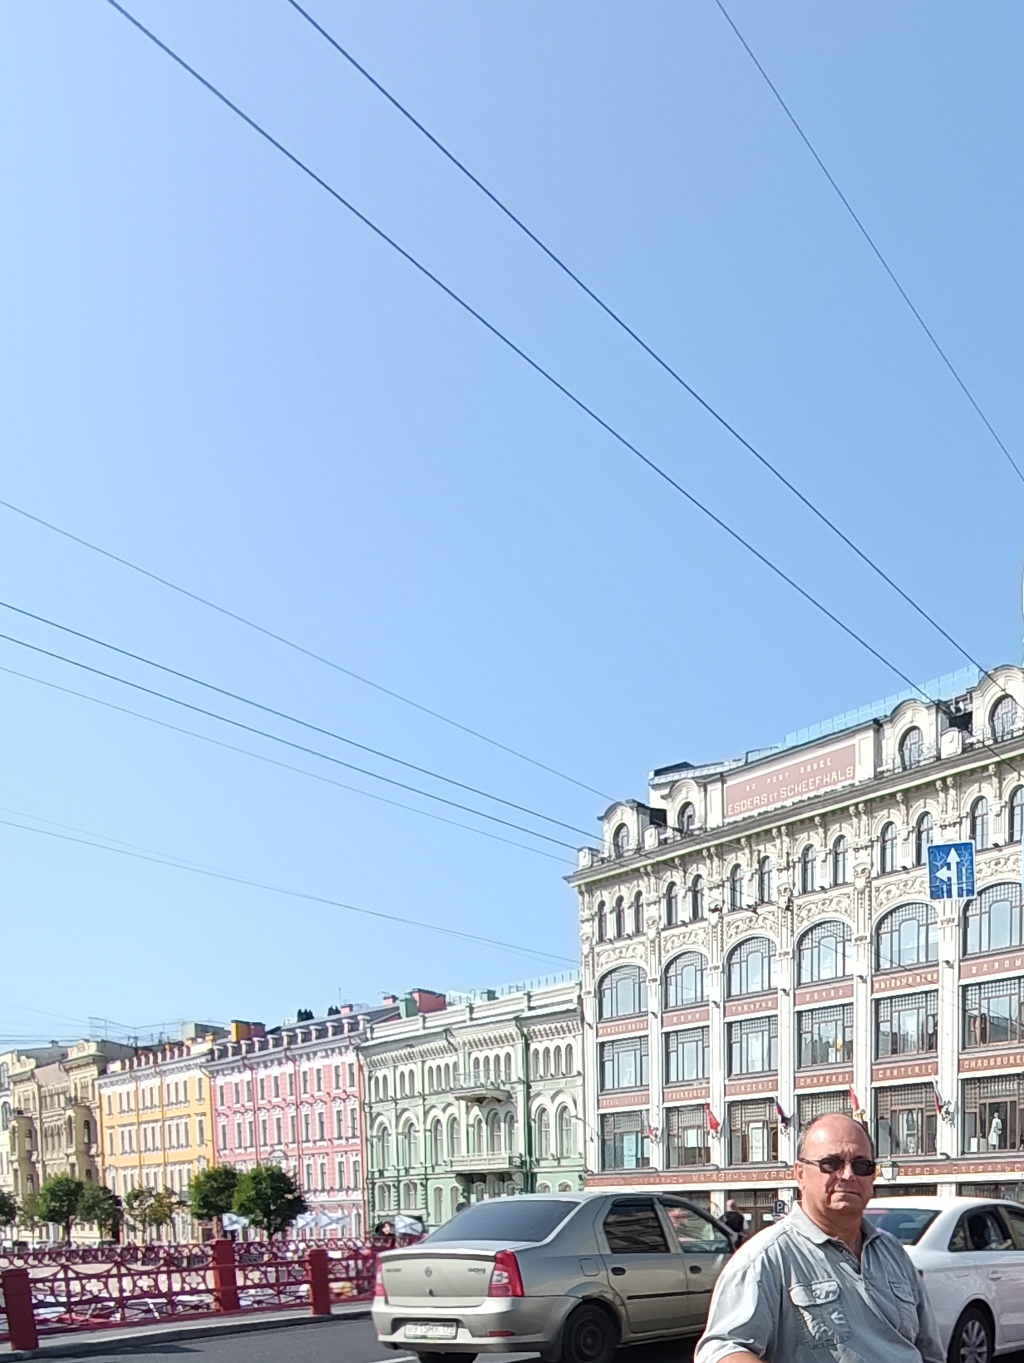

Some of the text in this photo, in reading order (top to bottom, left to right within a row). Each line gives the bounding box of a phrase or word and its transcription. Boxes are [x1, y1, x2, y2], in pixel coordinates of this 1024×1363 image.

[727, 793, 768, 816] ESDERS
[779, 766, 854, 798] SCHEEFHALS
[692, 1171, 747, 1182] МАГАЗИНЪ
